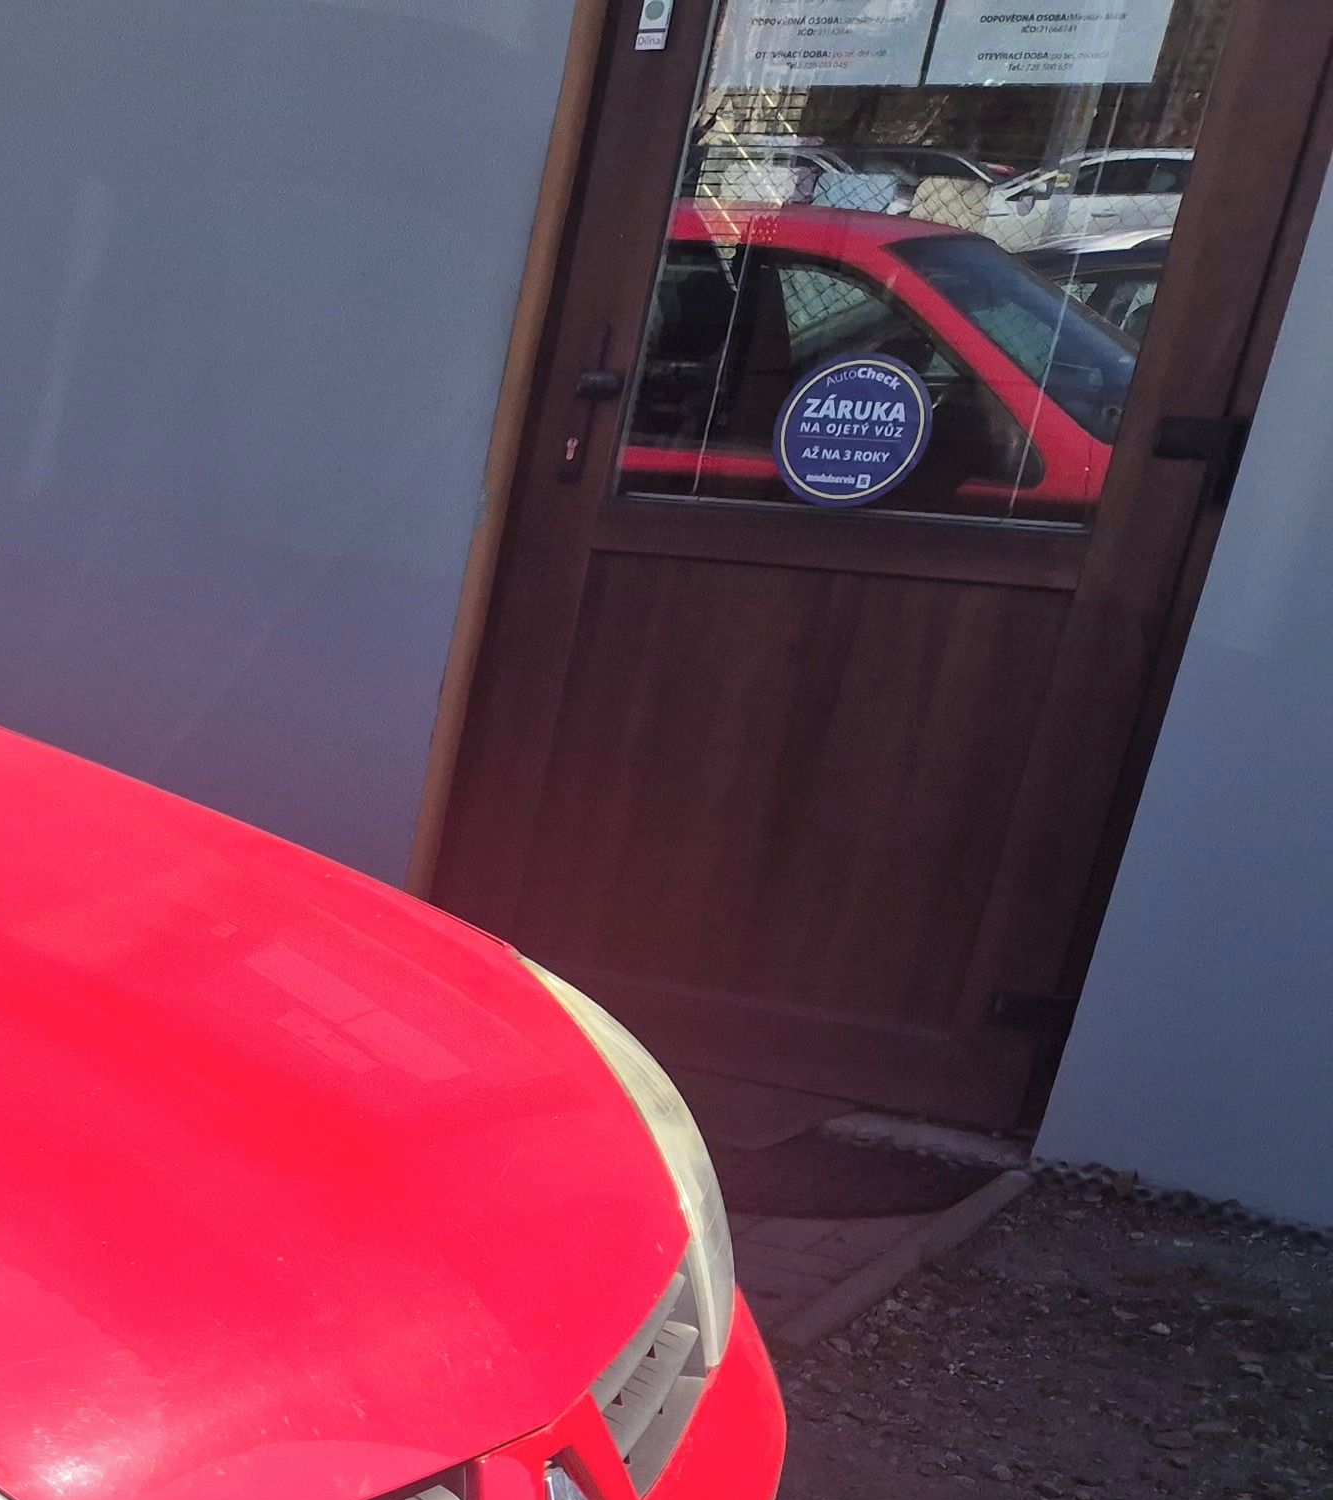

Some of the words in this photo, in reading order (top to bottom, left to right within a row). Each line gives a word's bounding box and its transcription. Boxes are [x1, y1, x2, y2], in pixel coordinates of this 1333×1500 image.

[826, 367, 901, 391] AutoCheck
[803, 394, 906, 422] ZÁRUKA
[800, 422, 820, 433] NA
[826, 423, 870, 436] OJETÝ
[875, 423, 904, 438] VŮZ
[802, 446, 820, 459] AŽ
[822, 449, 841, 460] NA
[842, 450, 851, 461] 3
[853, 451, 890, 463] ROKY
